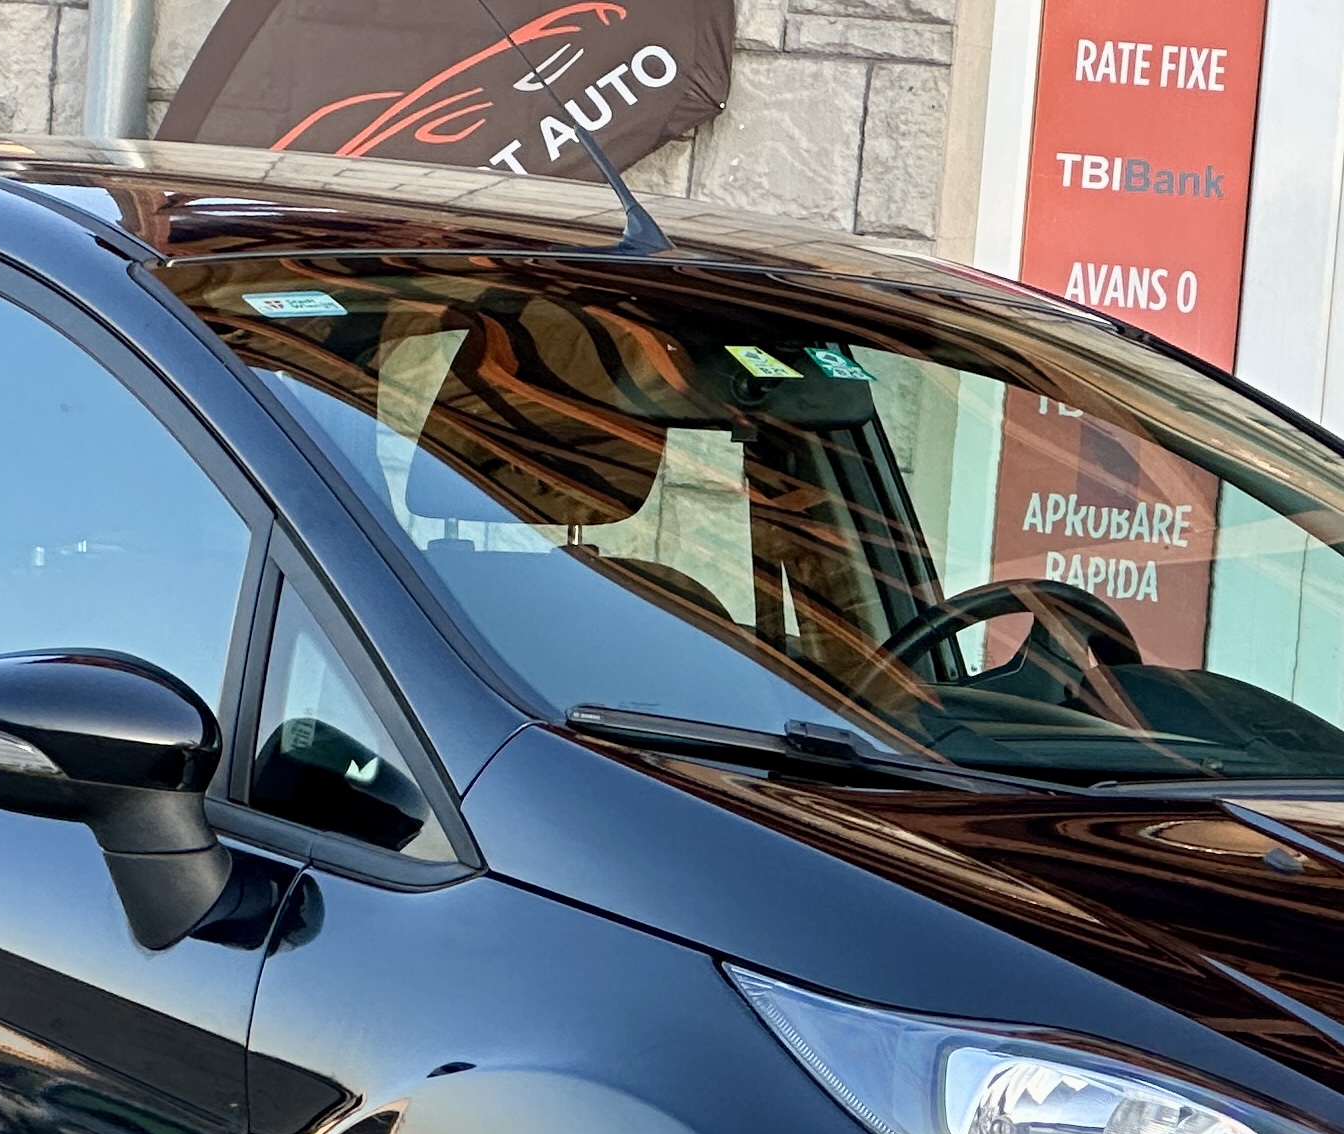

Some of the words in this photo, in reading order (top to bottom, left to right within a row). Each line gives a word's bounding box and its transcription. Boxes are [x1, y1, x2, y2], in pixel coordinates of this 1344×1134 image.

[1075, 39, 1153, 86] RATE
[1160, 45, 1227, 92] FIXE
[540, 45, 677, 161] AUTO
[1065, 261, 1169, 312] AVANS
